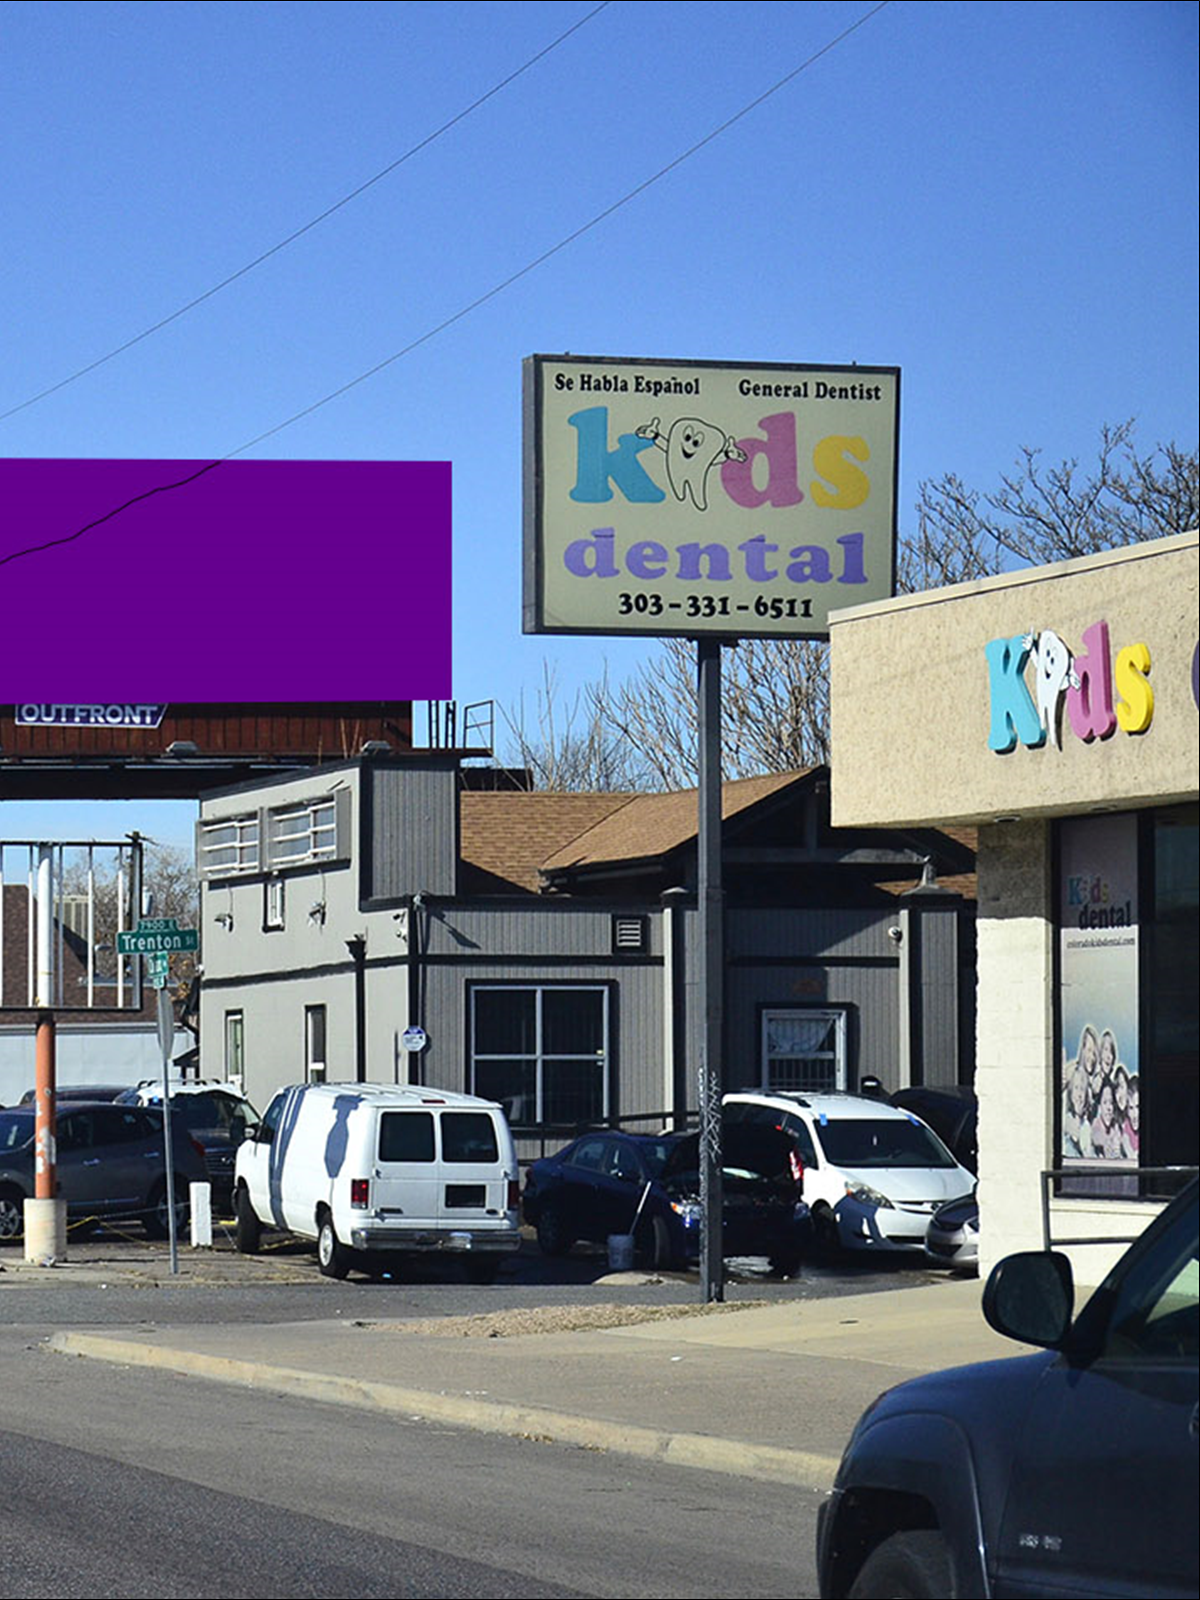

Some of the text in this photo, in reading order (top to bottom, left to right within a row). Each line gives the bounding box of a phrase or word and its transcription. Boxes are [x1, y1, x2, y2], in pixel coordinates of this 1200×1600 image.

[554, 373, 700, 397] Se Habla Español
[738, 379, 882, 401] General Dentist
[567, 406, 871, 511] kds
[563, 526, 869, 585] dental
[985, 619, 1154, 754] Kds
[20, 703, 158, 724] OUTFRONT
[1066, 874, 1109, 906] Kds
[1078, 900, 1132, 930] dental
[122, 935, 182, 950] Trenton
